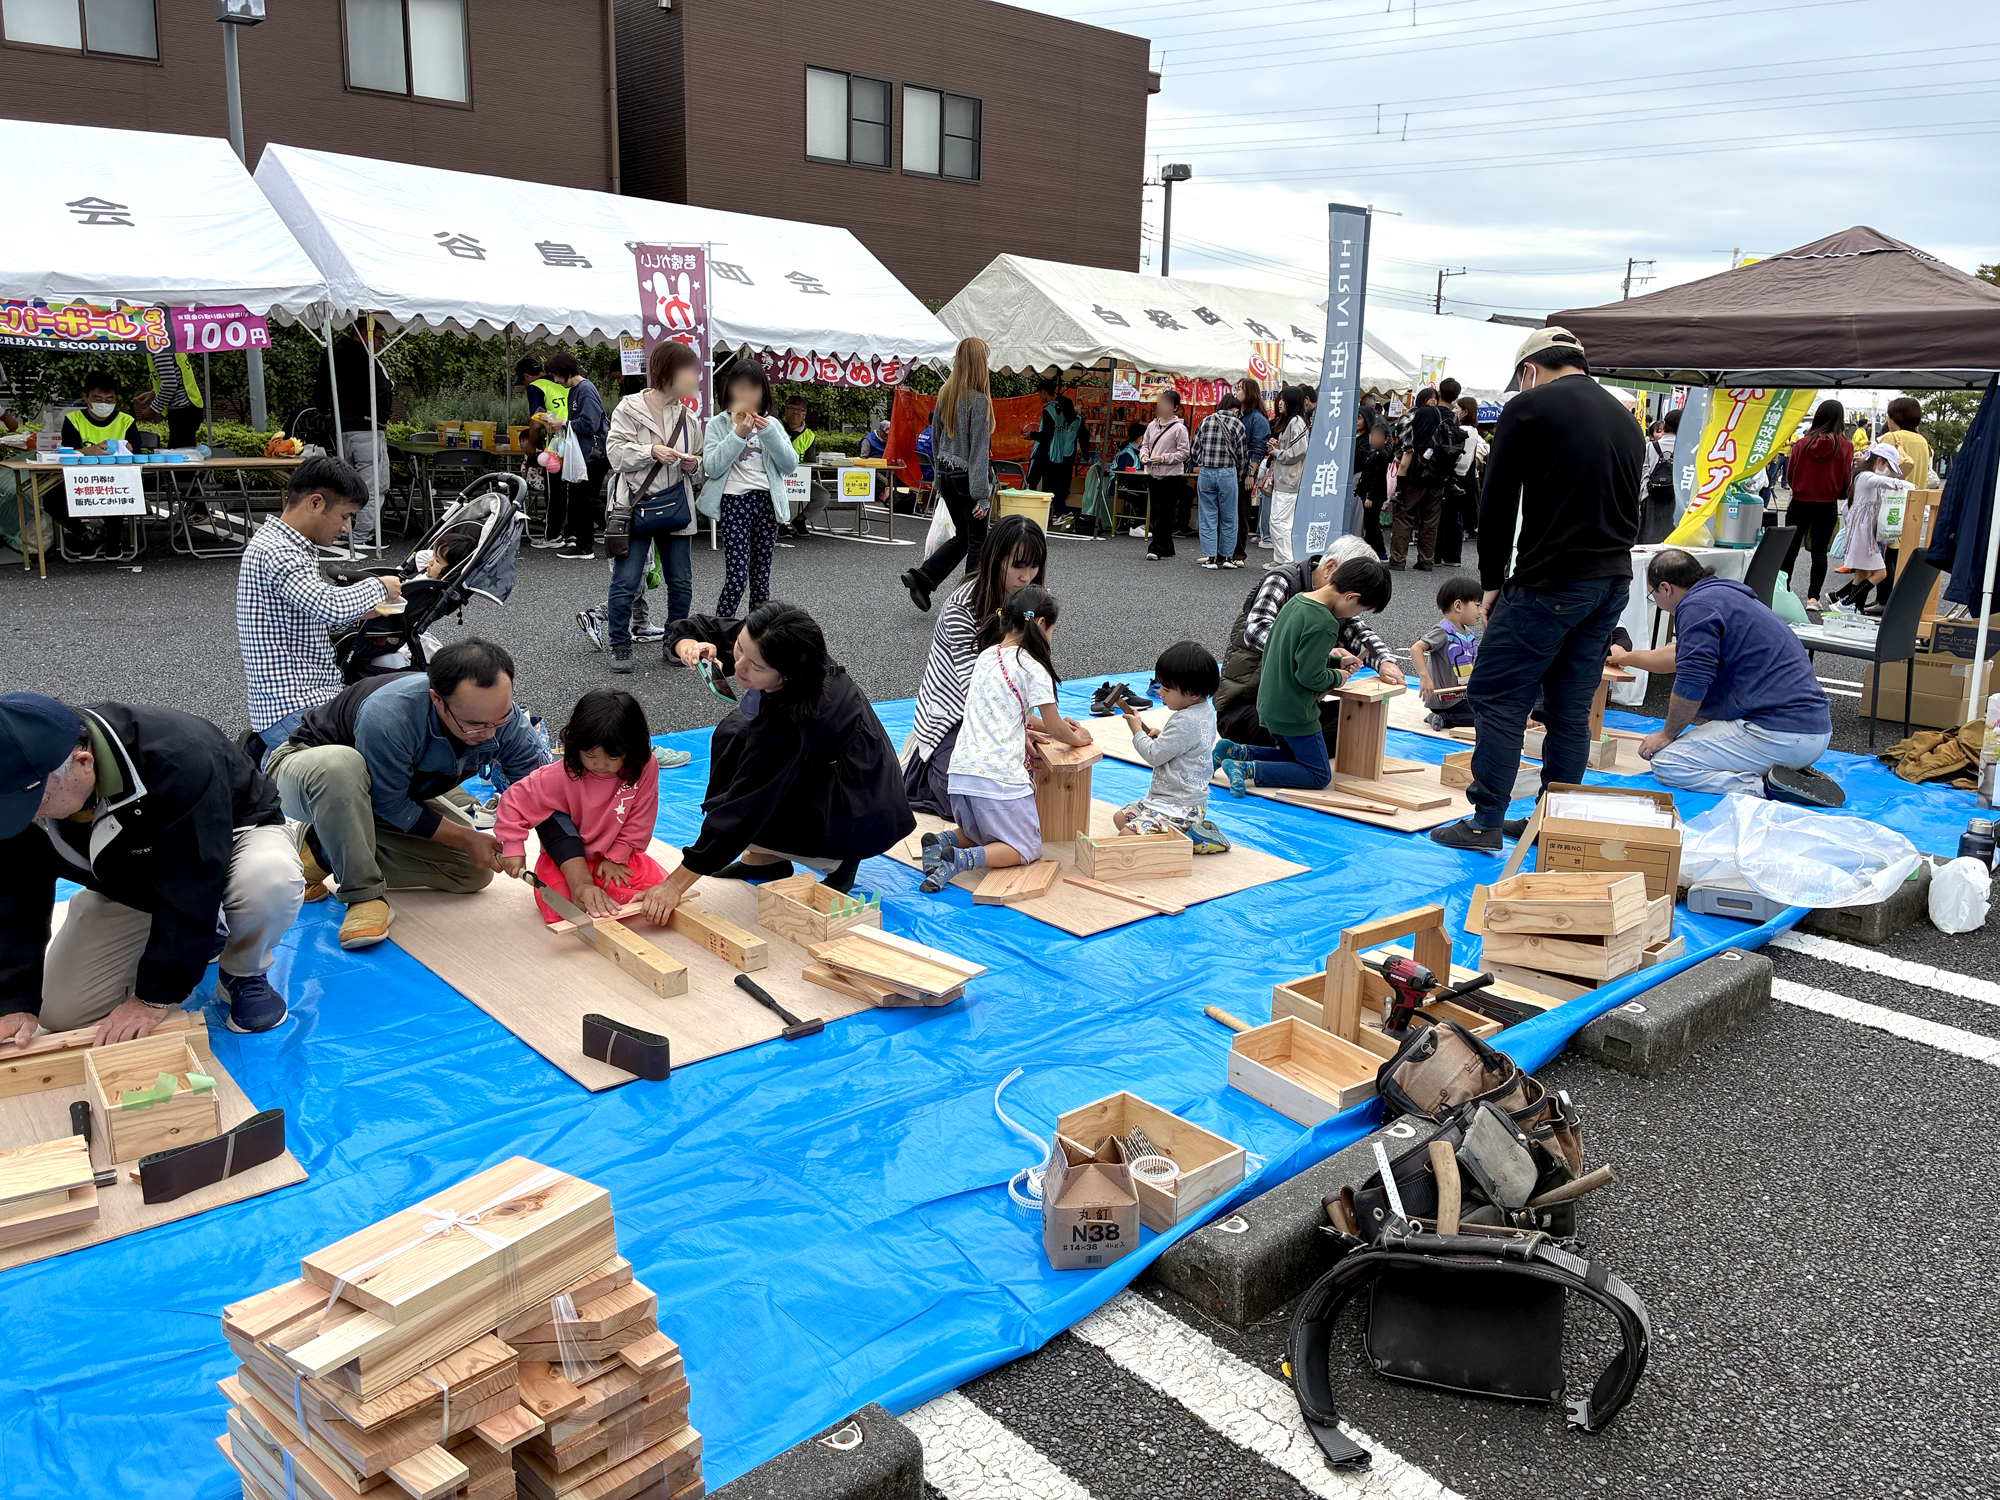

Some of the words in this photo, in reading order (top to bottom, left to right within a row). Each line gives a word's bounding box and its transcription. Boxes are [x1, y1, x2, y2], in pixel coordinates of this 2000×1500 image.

[65, 196, 135, 227] 会
[433, 231, 831, 296] 谷島町会
[145, 308, 170, 353] すくい
[184, 321, 268, 350] 100円
[59, 341, 138, 351] SCOOPING
[789, 356, 900, 385] かたぬき
[1748, 389, 1787, 469] ーム増改築の
[73, 476, 89, 484] 100
[74, 486, 130, 496] 本部受付にて
[75, 497, 136, 506] 販売しております
[1072, 1223, 1120, 1243] N38
